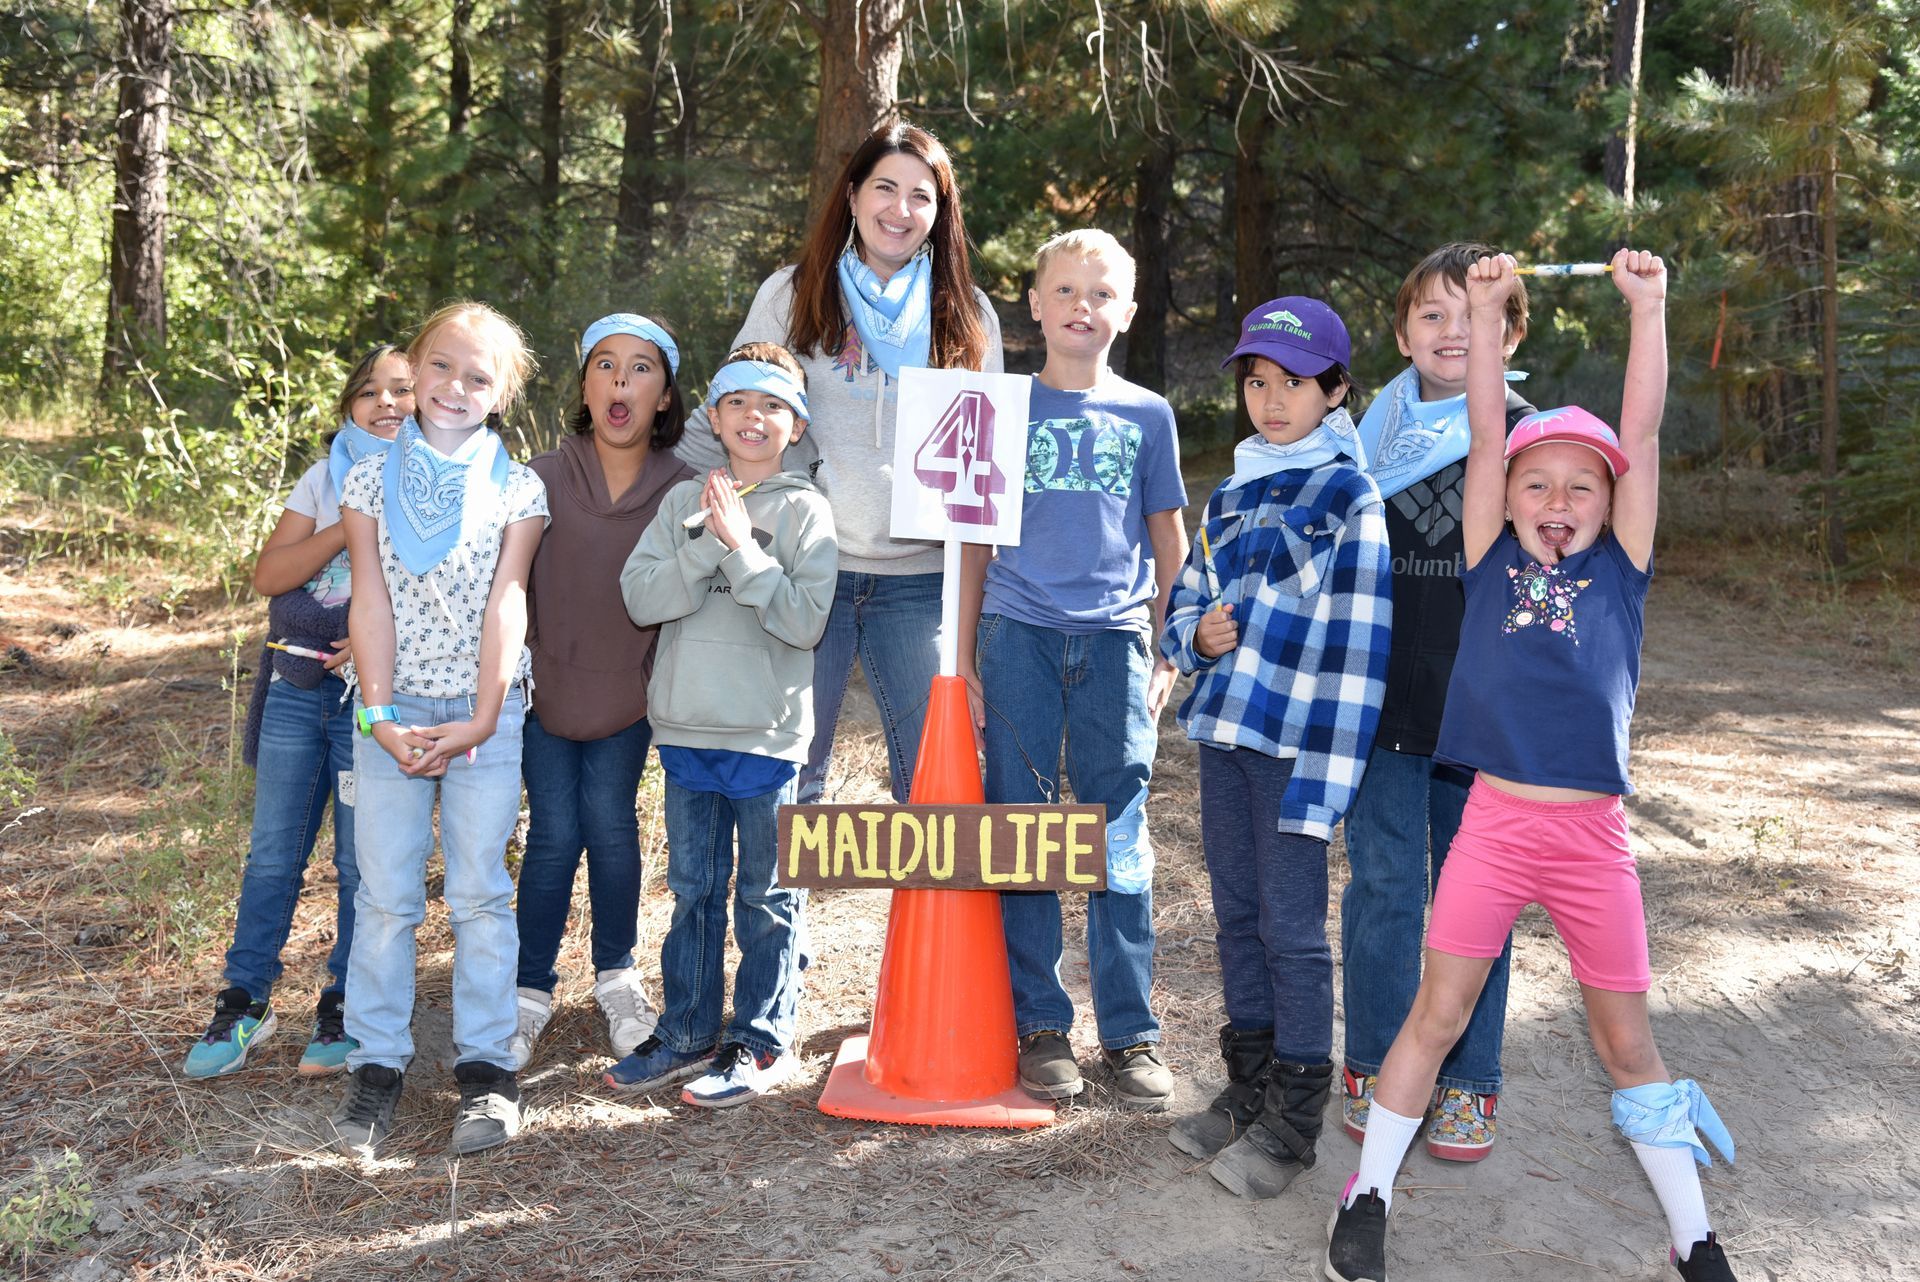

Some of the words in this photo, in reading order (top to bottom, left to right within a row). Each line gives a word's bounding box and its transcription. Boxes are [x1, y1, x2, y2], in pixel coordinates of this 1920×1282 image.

[1247, 323, 1283, 332] CALIFORNIA
[1284, 323, 1312, 341] CHROME
[914, 390, 1006, 526] 4
[788, 811, 956, 881] MAIDU
[979, 812, 1098, 884] LIFE
